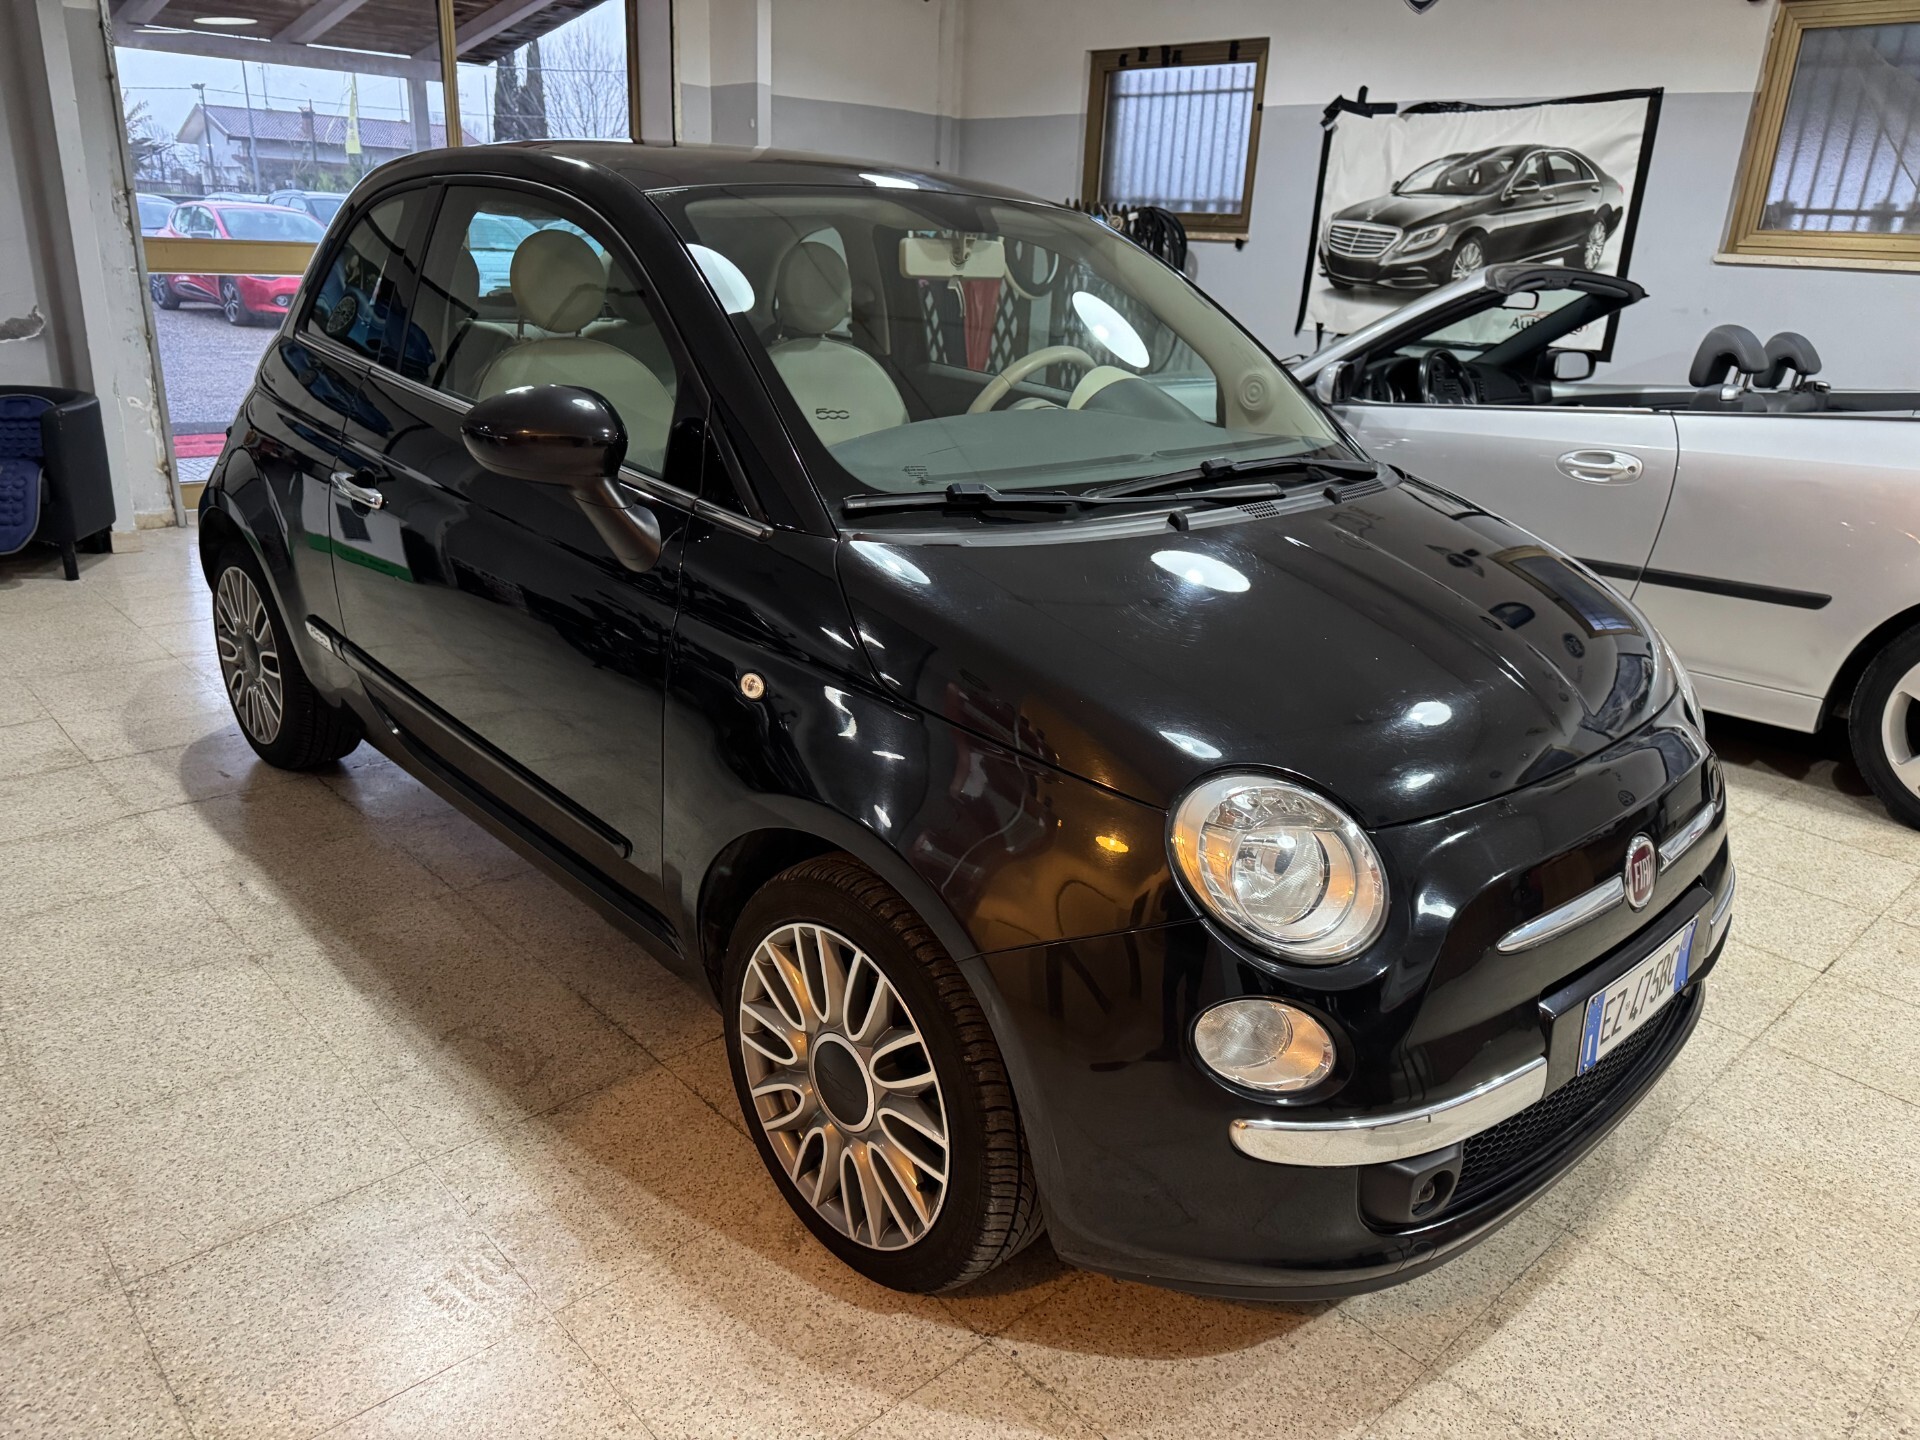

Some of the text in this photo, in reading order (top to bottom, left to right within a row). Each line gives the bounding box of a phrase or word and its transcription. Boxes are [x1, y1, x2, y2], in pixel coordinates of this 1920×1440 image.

[816, 408, 850, 420] 500
[1634, 854, 1651, 893] FIAT
[1600, 988, 1629, 1046] EZ
